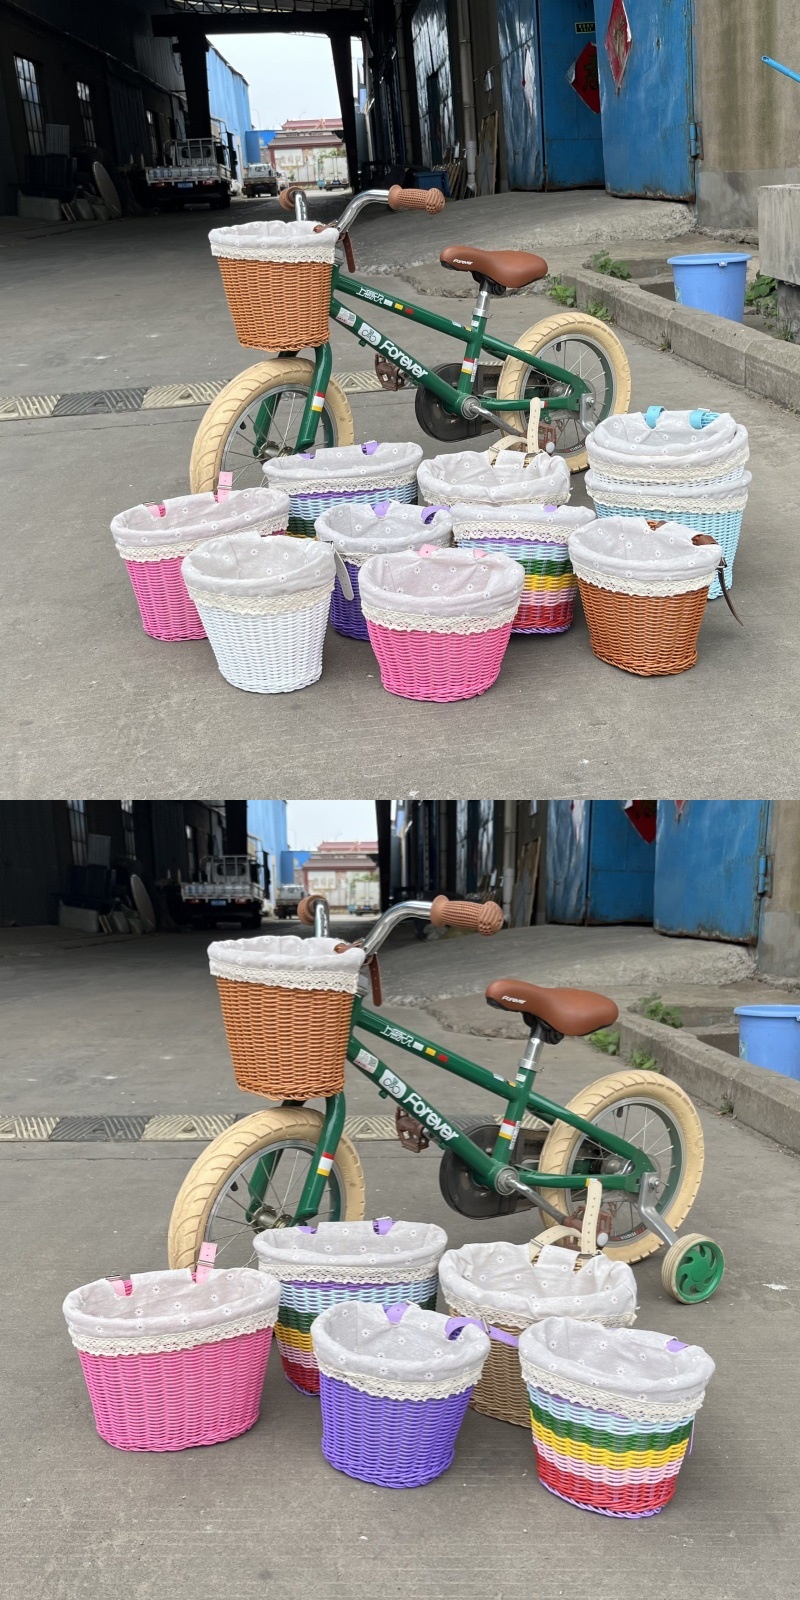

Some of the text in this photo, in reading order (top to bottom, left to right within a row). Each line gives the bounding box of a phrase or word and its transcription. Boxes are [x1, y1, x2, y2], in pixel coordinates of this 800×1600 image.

[379, 340, 428, 378] Forever
[501, 995, 526, 1004] Forever
[402, 1093, 459, 1141] Forever
